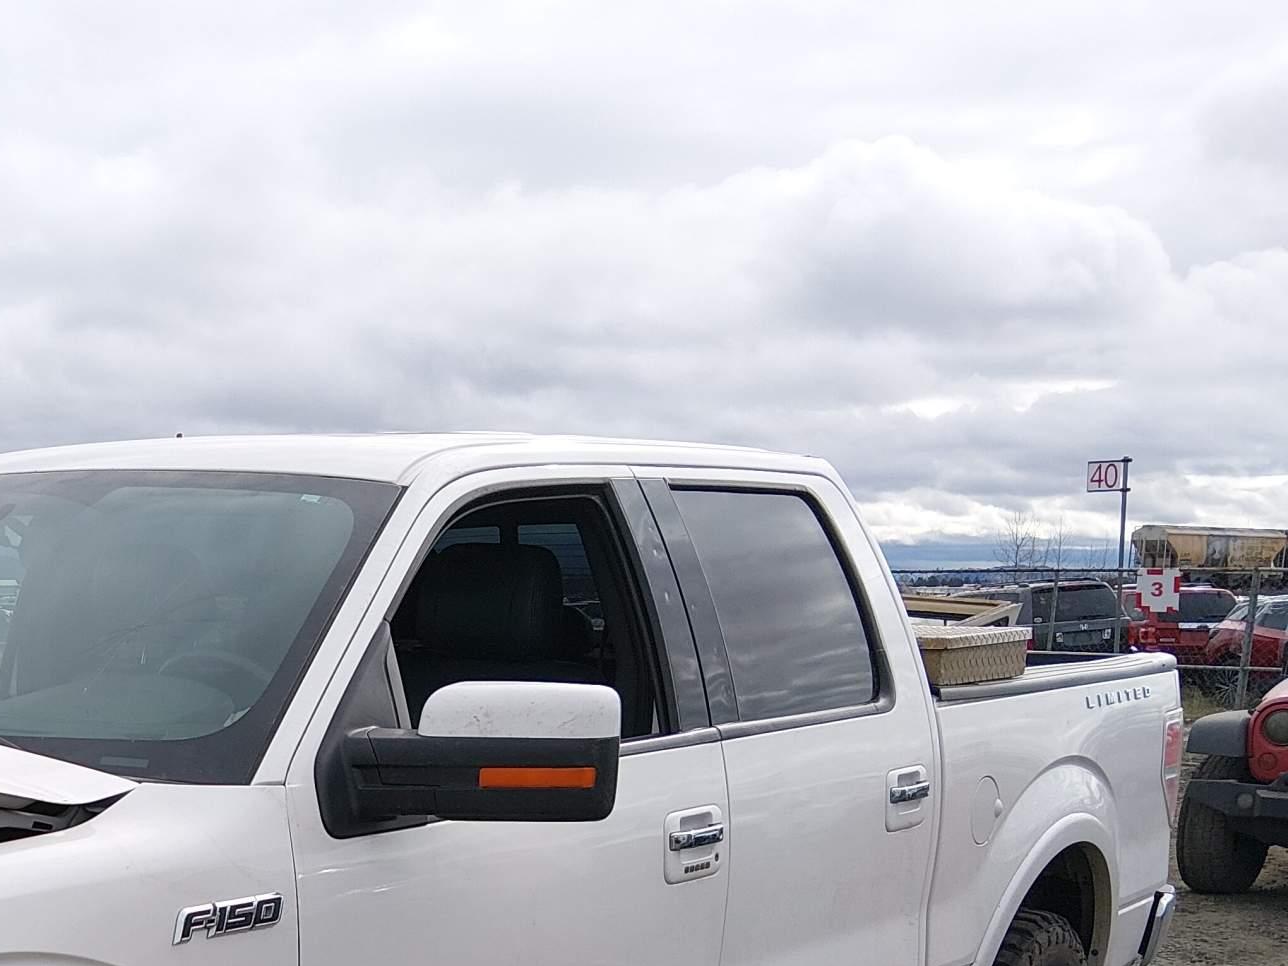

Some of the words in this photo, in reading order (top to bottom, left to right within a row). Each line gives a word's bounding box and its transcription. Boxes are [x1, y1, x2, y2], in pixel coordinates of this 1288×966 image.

[1089, 463, 1119, 489] 40
[1150, 581, 1164, 597] 3
[1085, 686, 1152, 710] LIMITED
[172, 891, 284, 945] F-150
